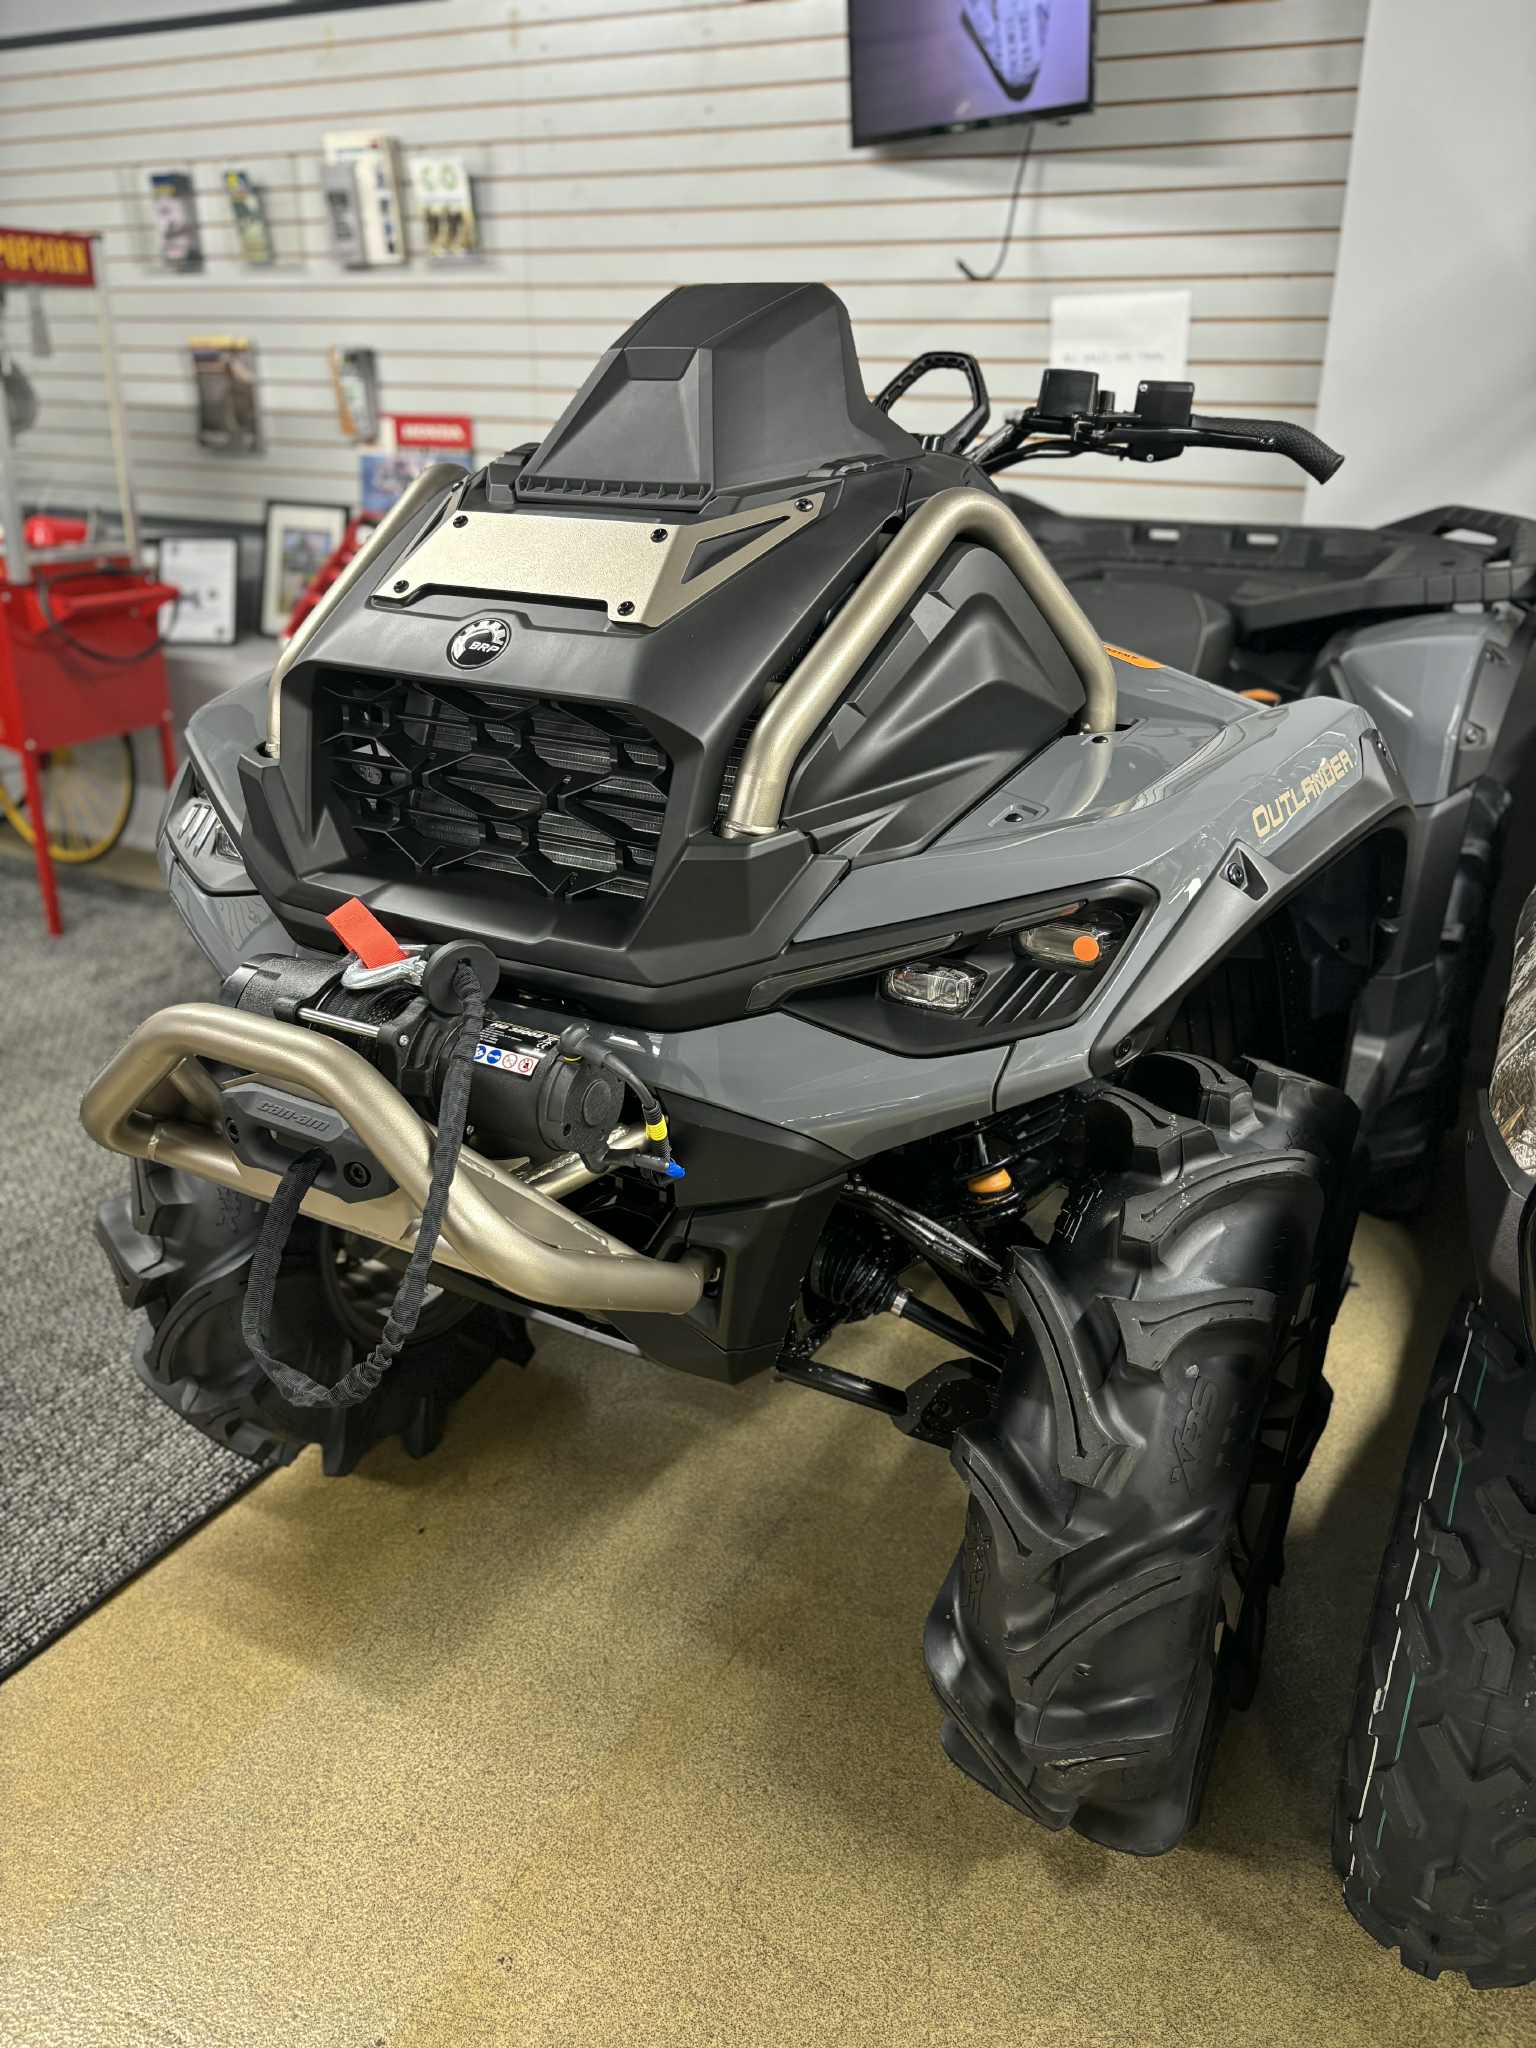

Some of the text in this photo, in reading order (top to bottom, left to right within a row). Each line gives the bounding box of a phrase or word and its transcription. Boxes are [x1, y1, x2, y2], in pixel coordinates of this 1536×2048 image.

[468, 641, 501, 653] BRP
[1251, 748, 1355, 839] OUTLANDER
[257, 1101, 330, 1133] can-am
